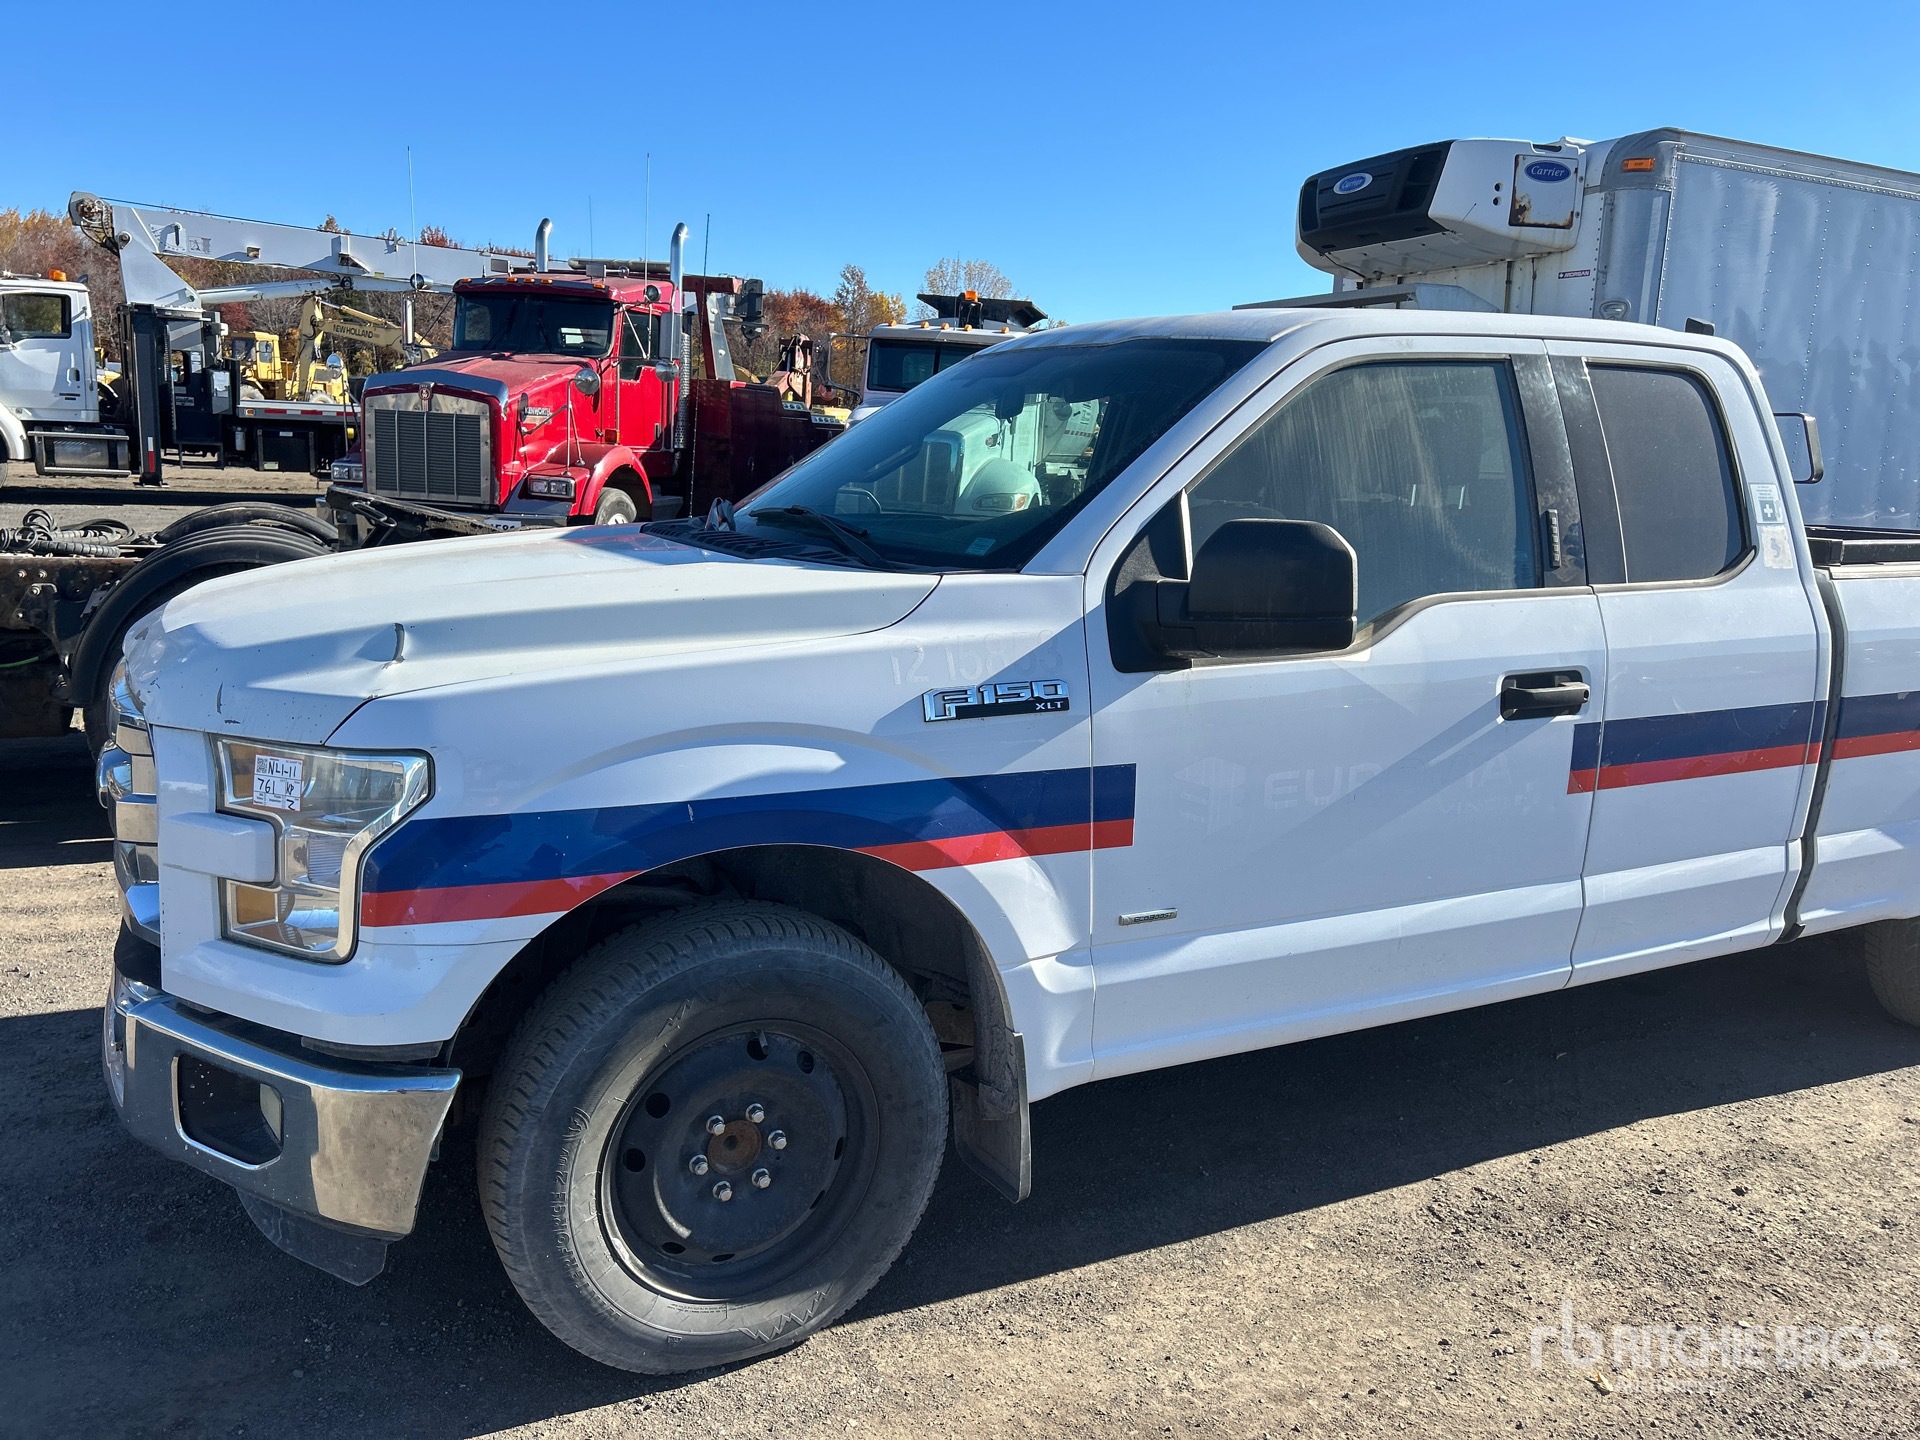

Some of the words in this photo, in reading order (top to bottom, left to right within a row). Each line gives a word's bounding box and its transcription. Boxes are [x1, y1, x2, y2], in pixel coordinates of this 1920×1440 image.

[1531, 166, 1564, 176] Carrier
[333, 324, 346, 333] NEW
[346, 327, 374, 338] HOLLAND
[1035, 701, 1064, 711] XLT
[257, 777, 275, 794] 761
